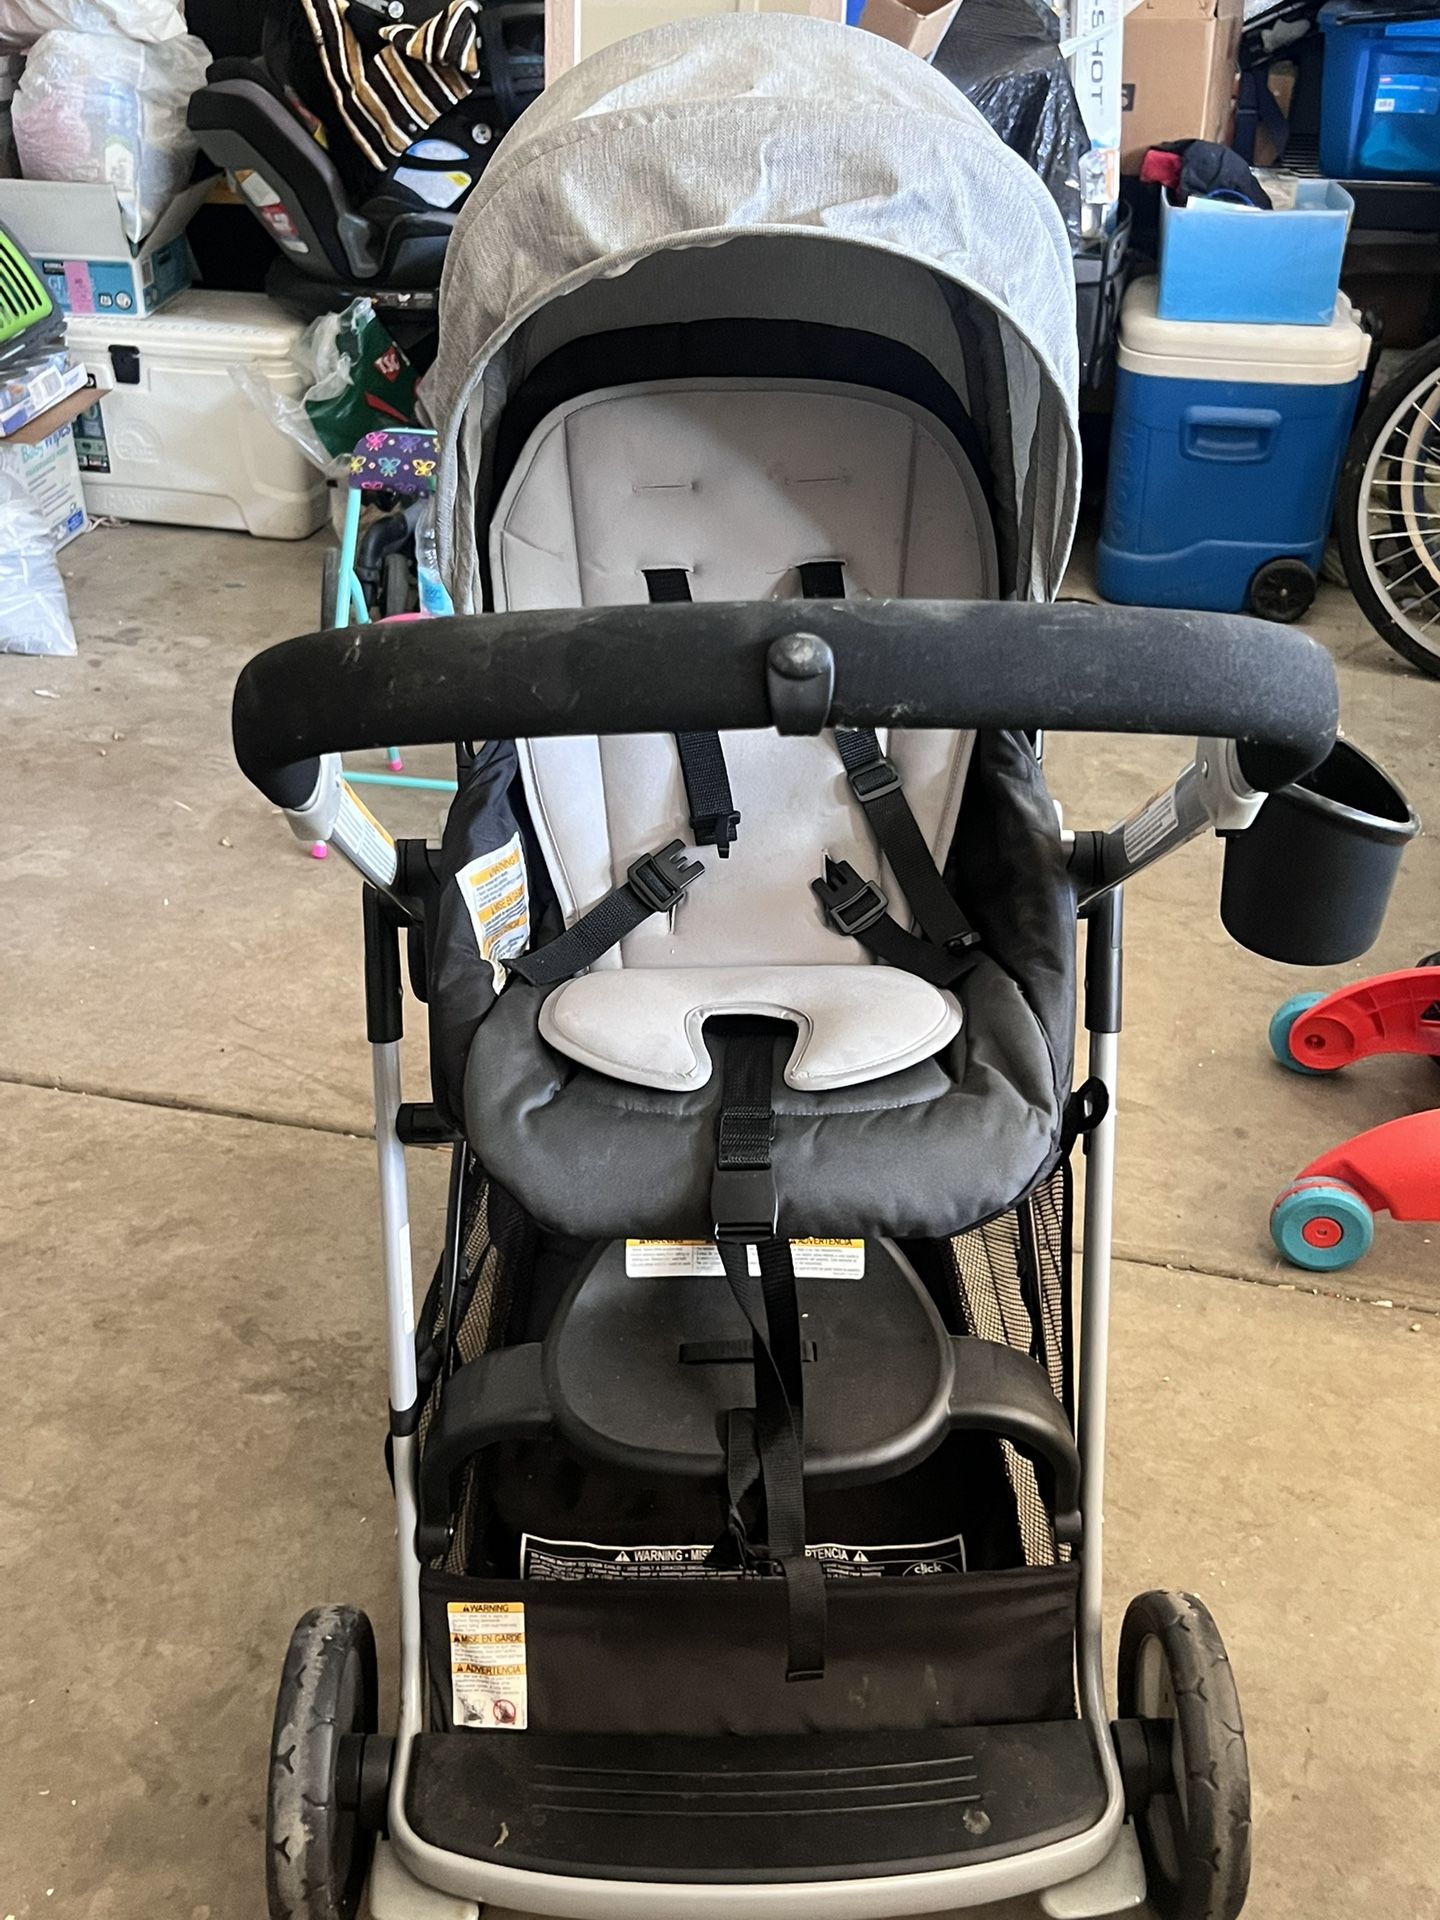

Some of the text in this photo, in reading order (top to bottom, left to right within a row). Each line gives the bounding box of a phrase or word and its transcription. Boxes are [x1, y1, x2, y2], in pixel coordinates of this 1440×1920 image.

[634, 1547, 849, 1562] WARNING MIS RTENCIA
[469, 1603, 509, 1612] WARNING
[481, 1635, 493, 1643] EN
